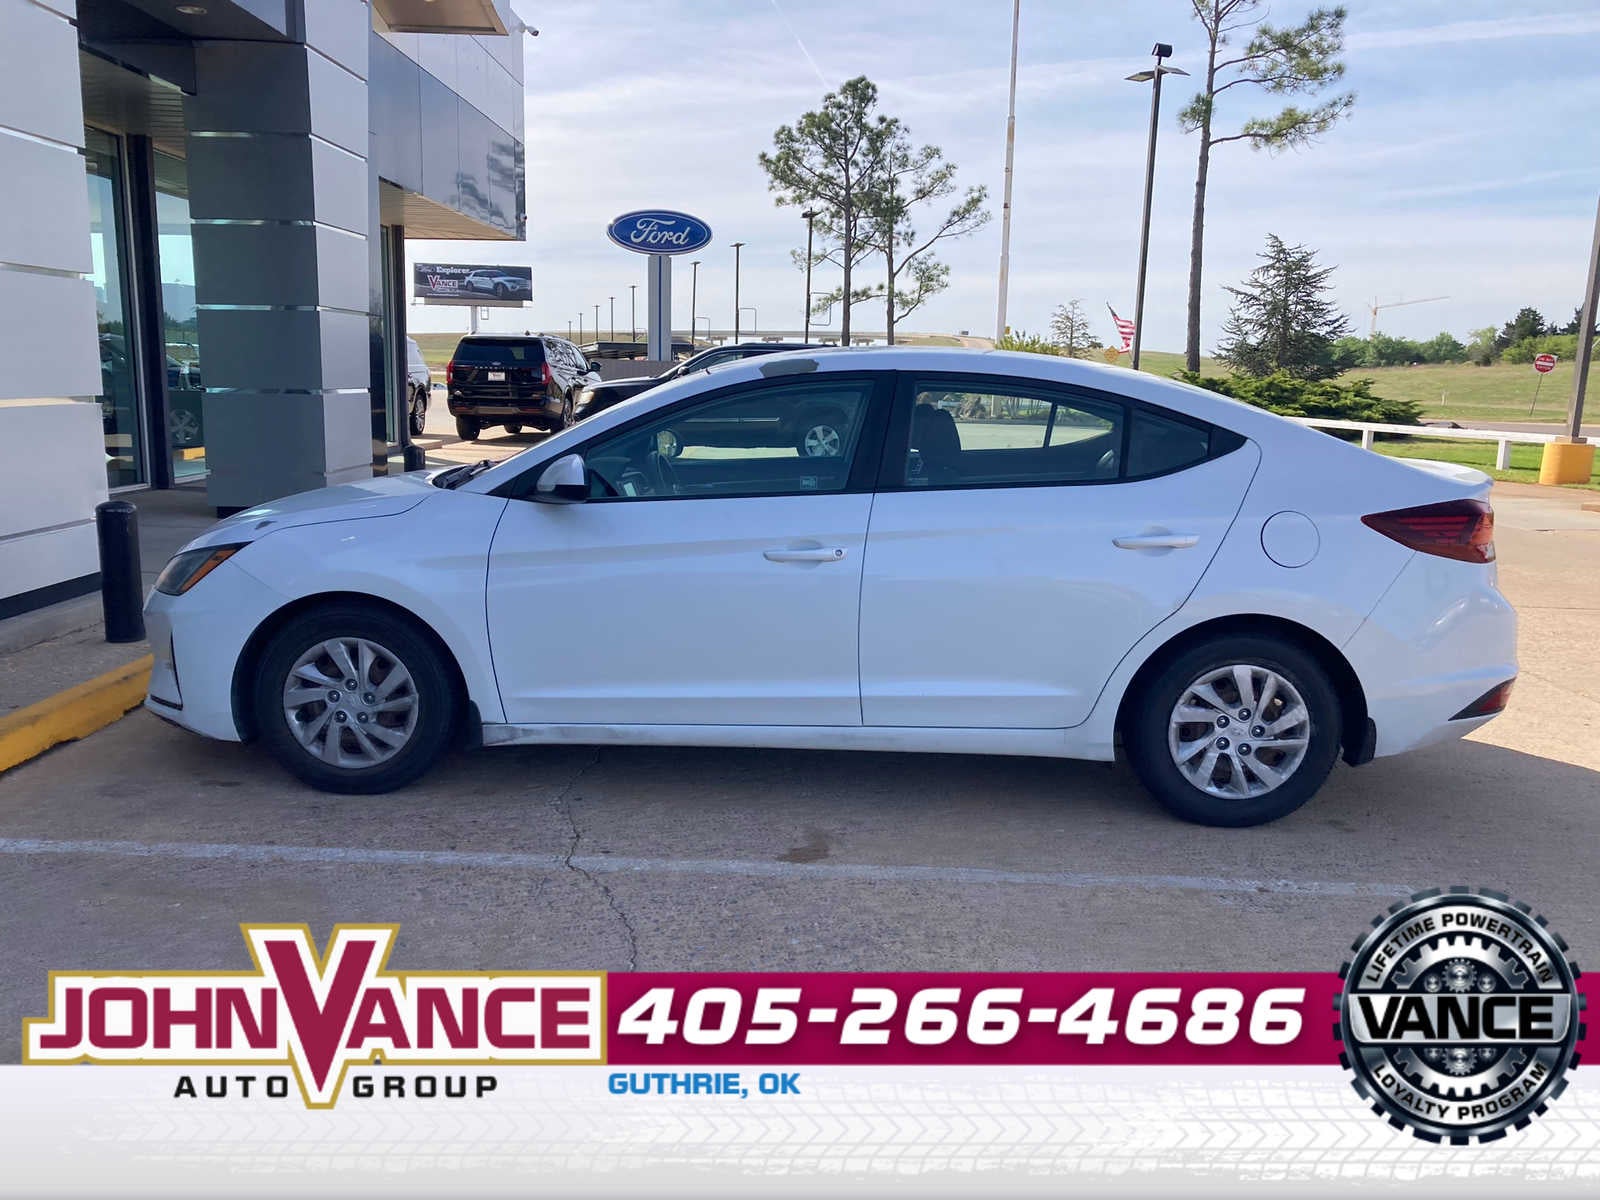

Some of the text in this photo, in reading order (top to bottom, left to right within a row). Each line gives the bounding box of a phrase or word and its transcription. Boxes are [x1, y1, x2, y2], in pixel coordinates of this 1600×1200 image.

[630, 217, 690, 245] Ford
[436, 266, 470, 275] Explorer
[428, 275, 457, 289] VANCE
